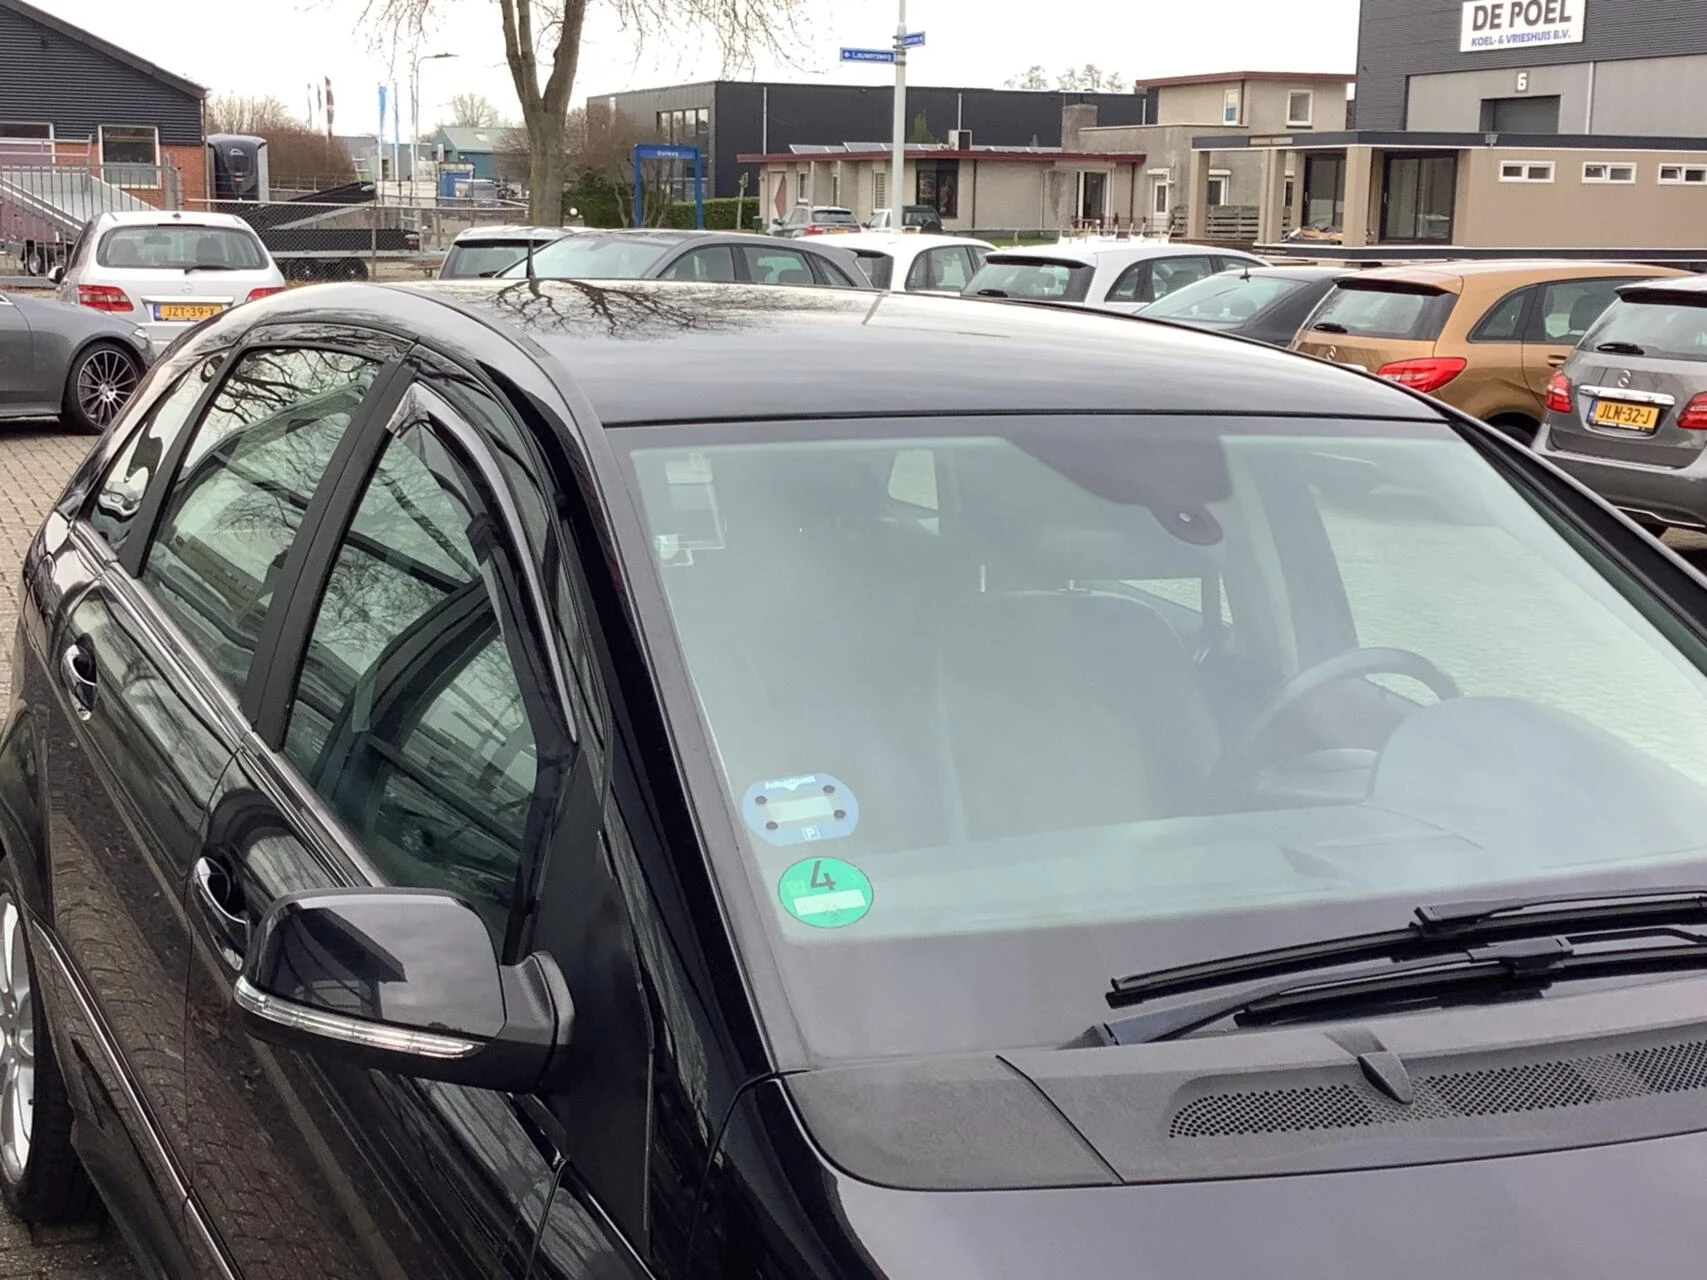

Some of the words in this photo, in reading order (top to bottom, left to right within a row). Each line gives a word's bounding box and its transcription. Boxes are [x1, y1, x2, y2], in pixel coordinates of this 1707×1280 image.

[1472, 3, 1504, 31] DE
[1509, 0, 1572, 28] POEL
[1471, 36, 1497, 47] KOEL-
[1498, 35, 1504, 45] &
[1506, 30, 1552, 44] VRIESHUIS
[1553, 29, 1571, 40] B.V.
[1517, 72, 1527, 91] 6
[1599, 404, 1652, 425] JLN-32-J
[810, 860, 836, 890] 4
